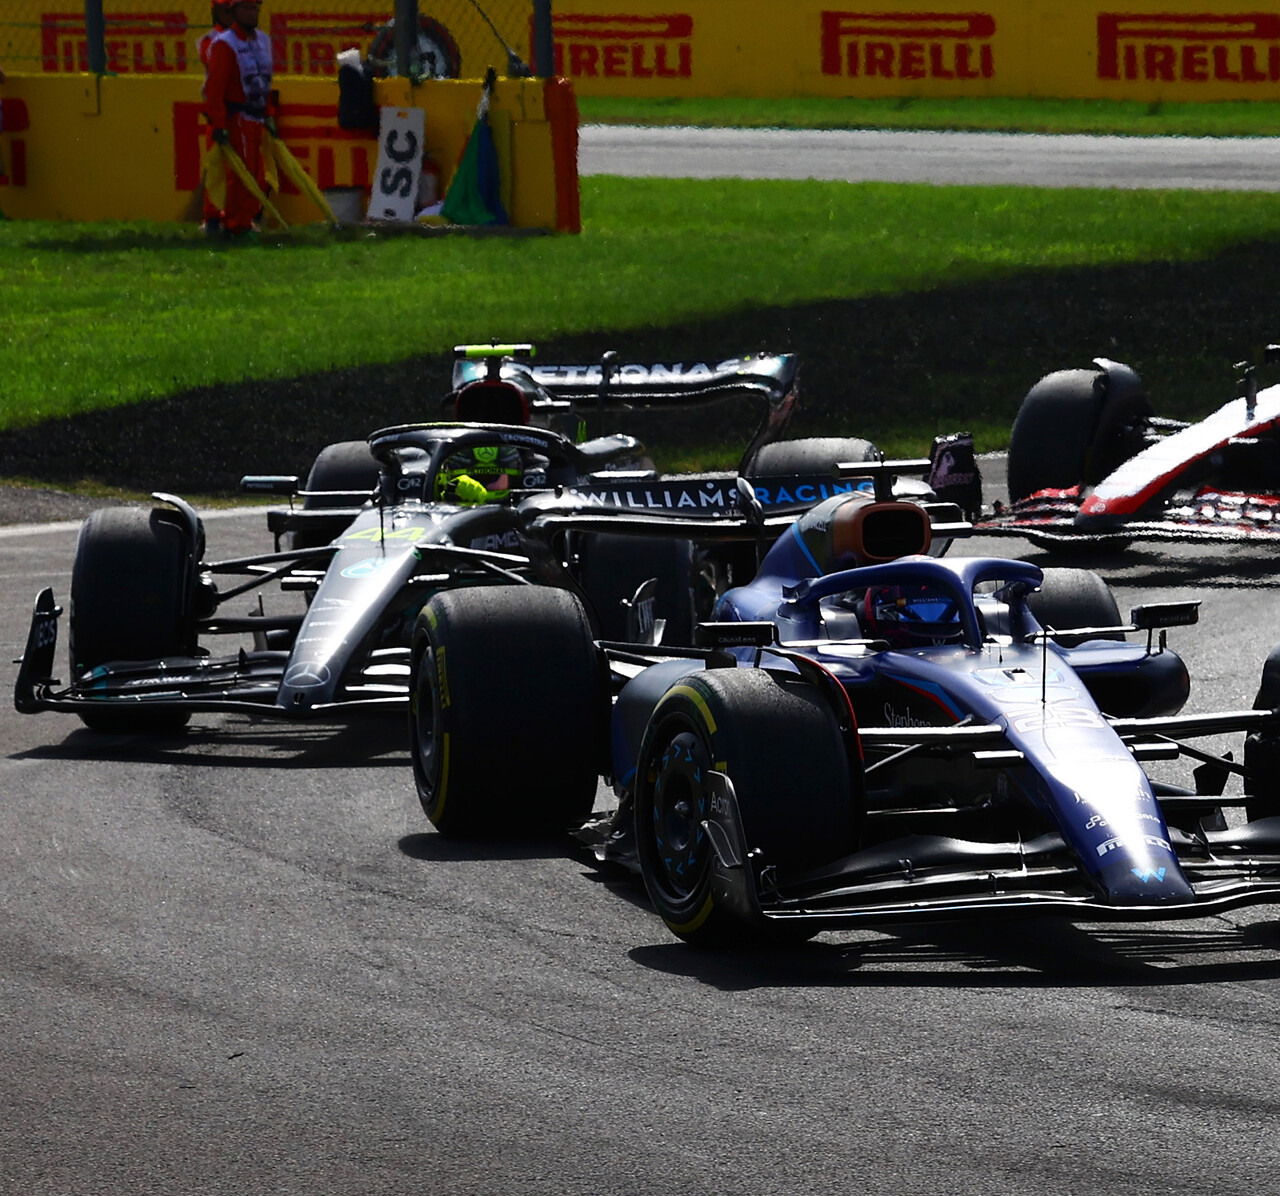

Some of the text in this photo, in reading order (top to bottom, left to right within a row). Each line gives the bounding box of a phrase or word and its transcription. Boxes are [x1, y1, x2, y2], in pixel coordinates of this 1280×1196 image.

[821, 11, 996, 79] PIRELLI
[380, 129, 418, 197] SC
[345, 526, 429, 544] 44
